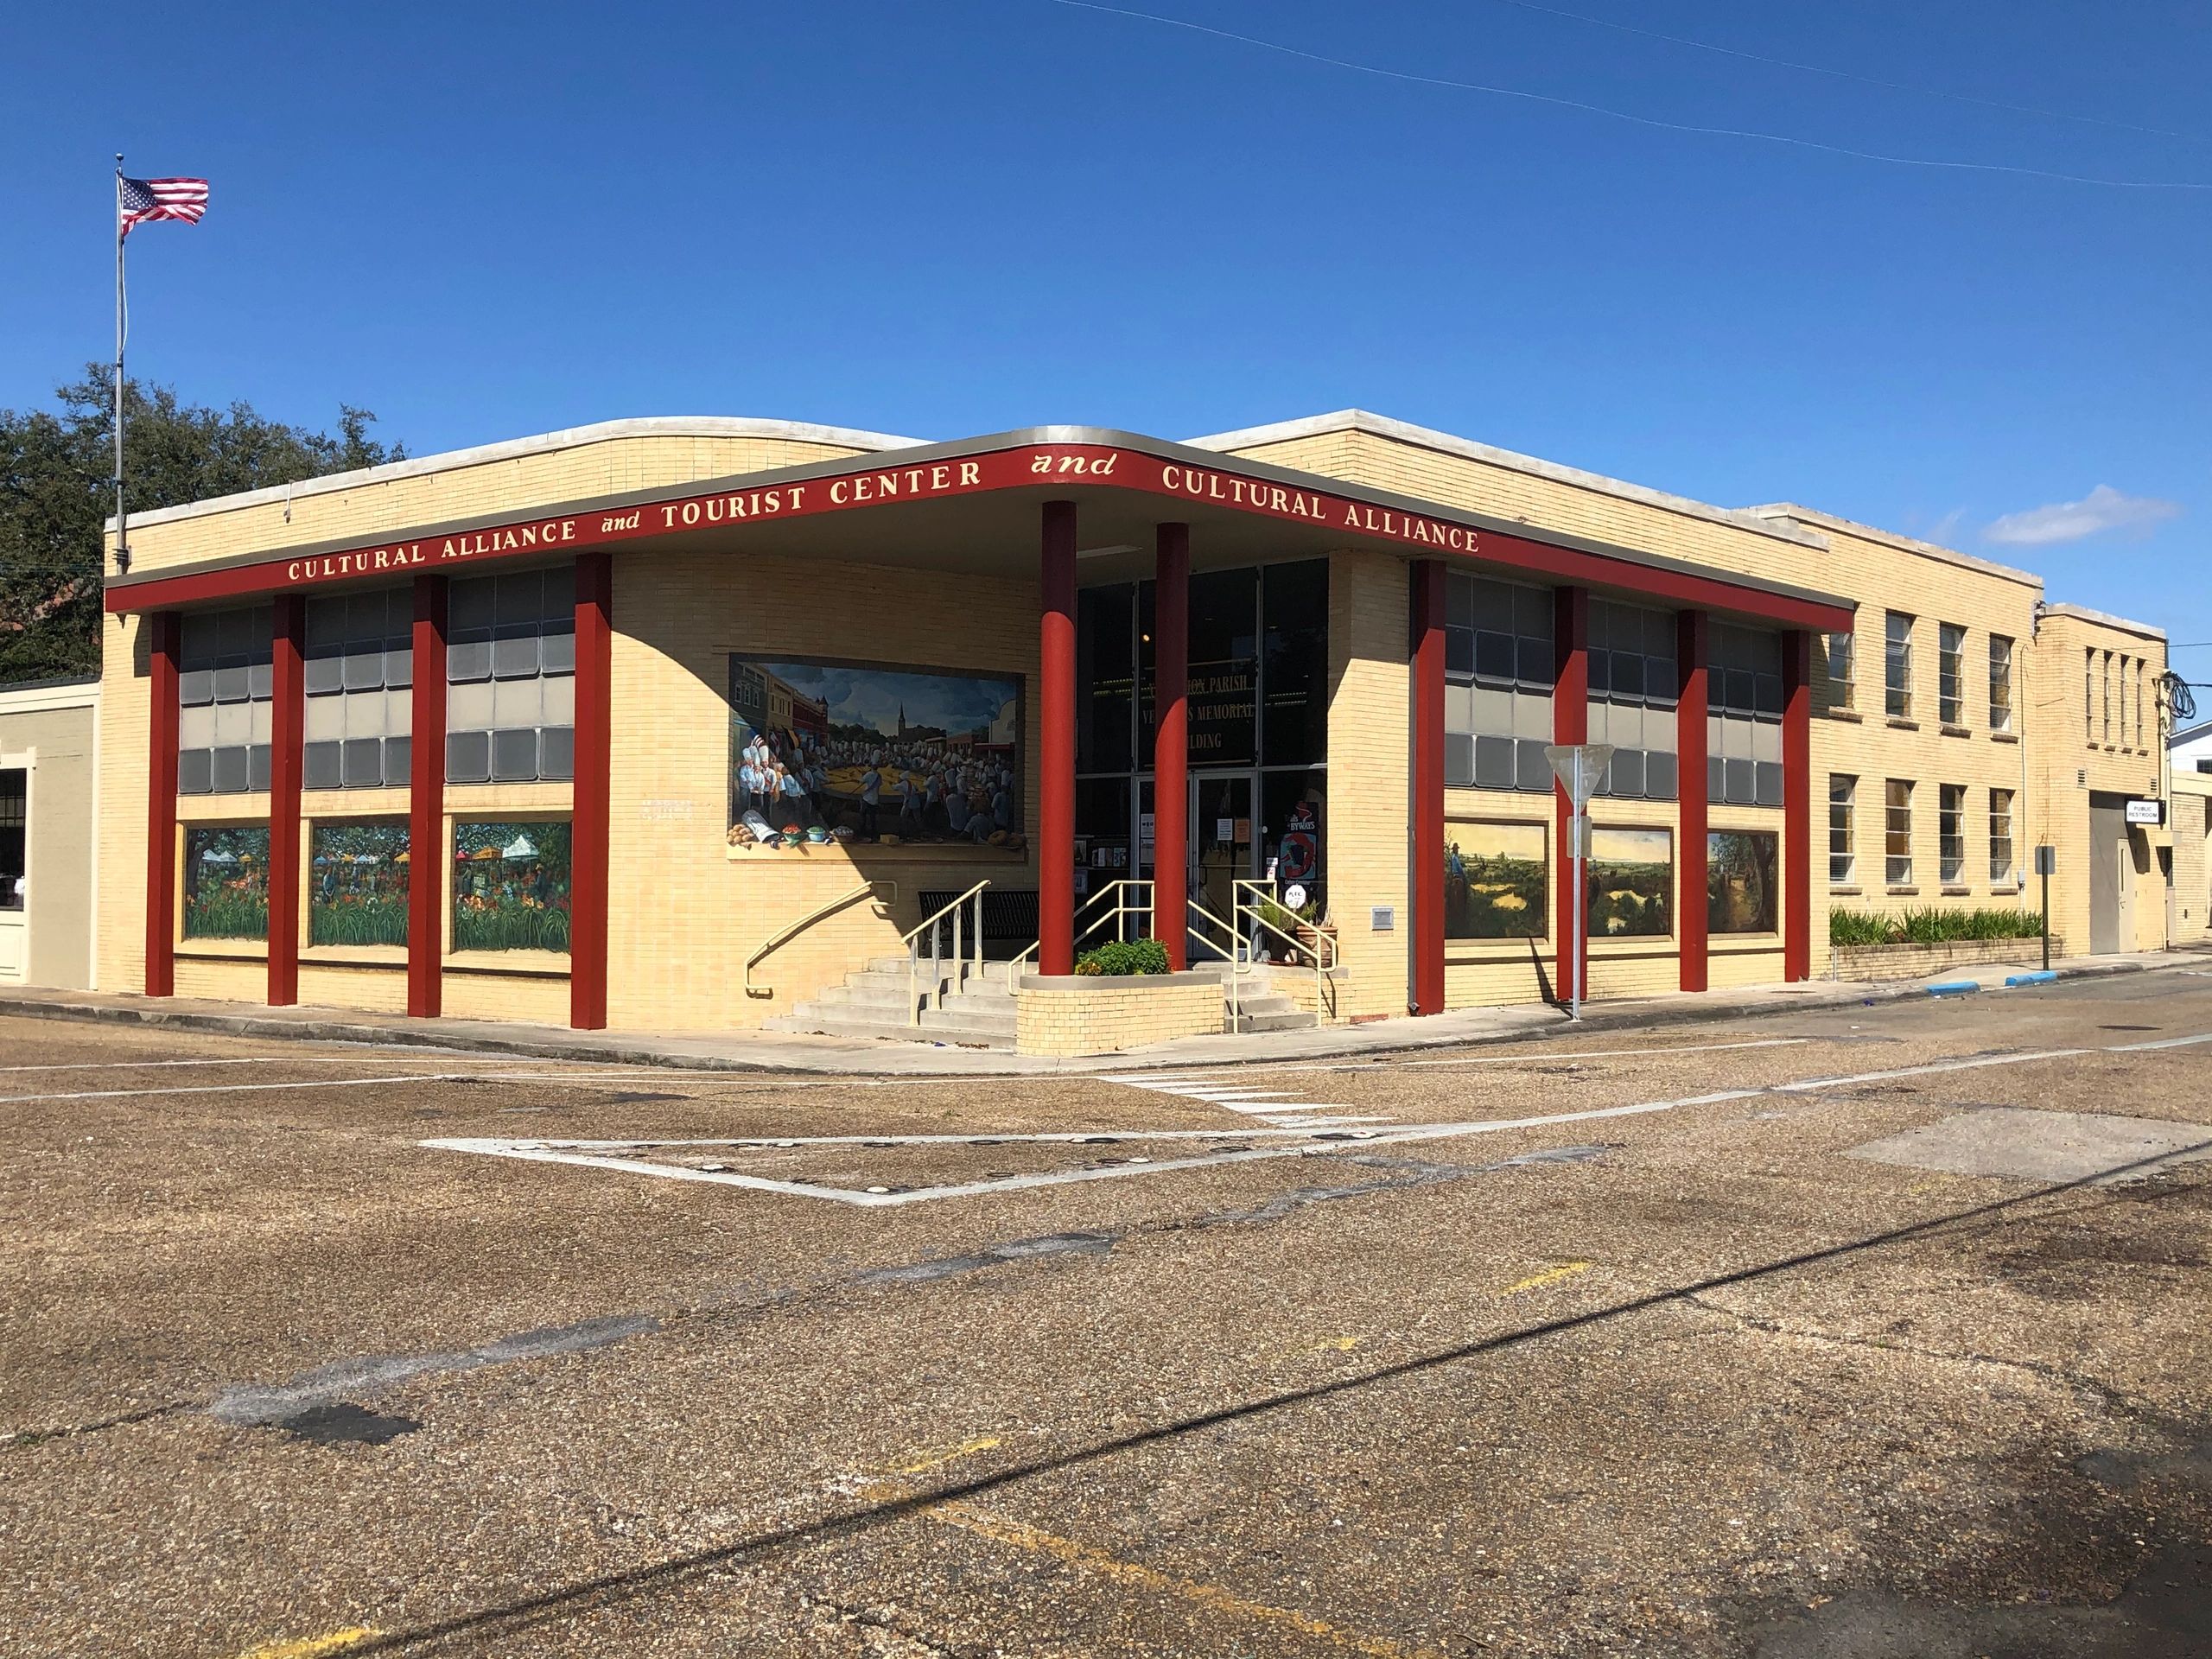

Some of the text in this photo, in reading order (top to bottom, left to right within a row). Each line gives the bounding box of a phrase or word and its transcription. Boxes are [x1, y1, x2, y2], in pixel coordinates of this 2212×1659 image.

[289, 453, 1479, 580] CULTURAL ALLIANCE and TOURIST CENTER and CULTURAL ALLIANCE
[1210, 675, 1247, 693] PARISH
[1198, 703, 1254, 721] MEMORIAL
[1188, 732, 1222, 749] LDING
[1290, 821, 1315, 830] BYWAYS
